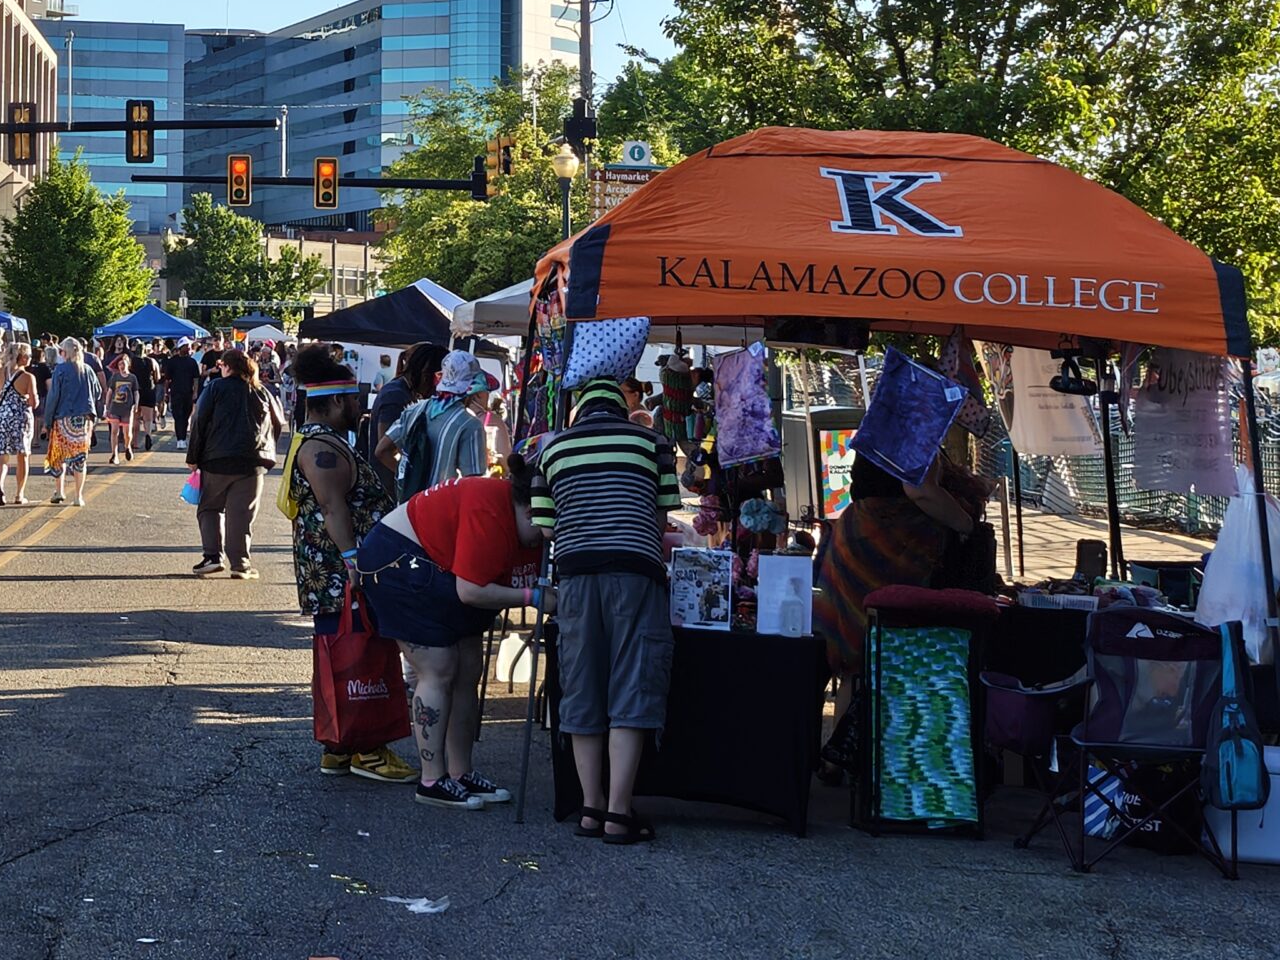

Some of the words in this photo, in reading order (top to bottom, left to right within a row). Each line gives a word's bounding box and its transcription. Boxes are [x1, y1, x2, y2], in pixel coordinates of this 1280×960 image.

[605, 171, 650, 182] Haymarket
[819, 167, 963, 238] K
[658, 256, 946, 302] KALAMAZOO
[952, 271, 1160, 313] COLLEGE
